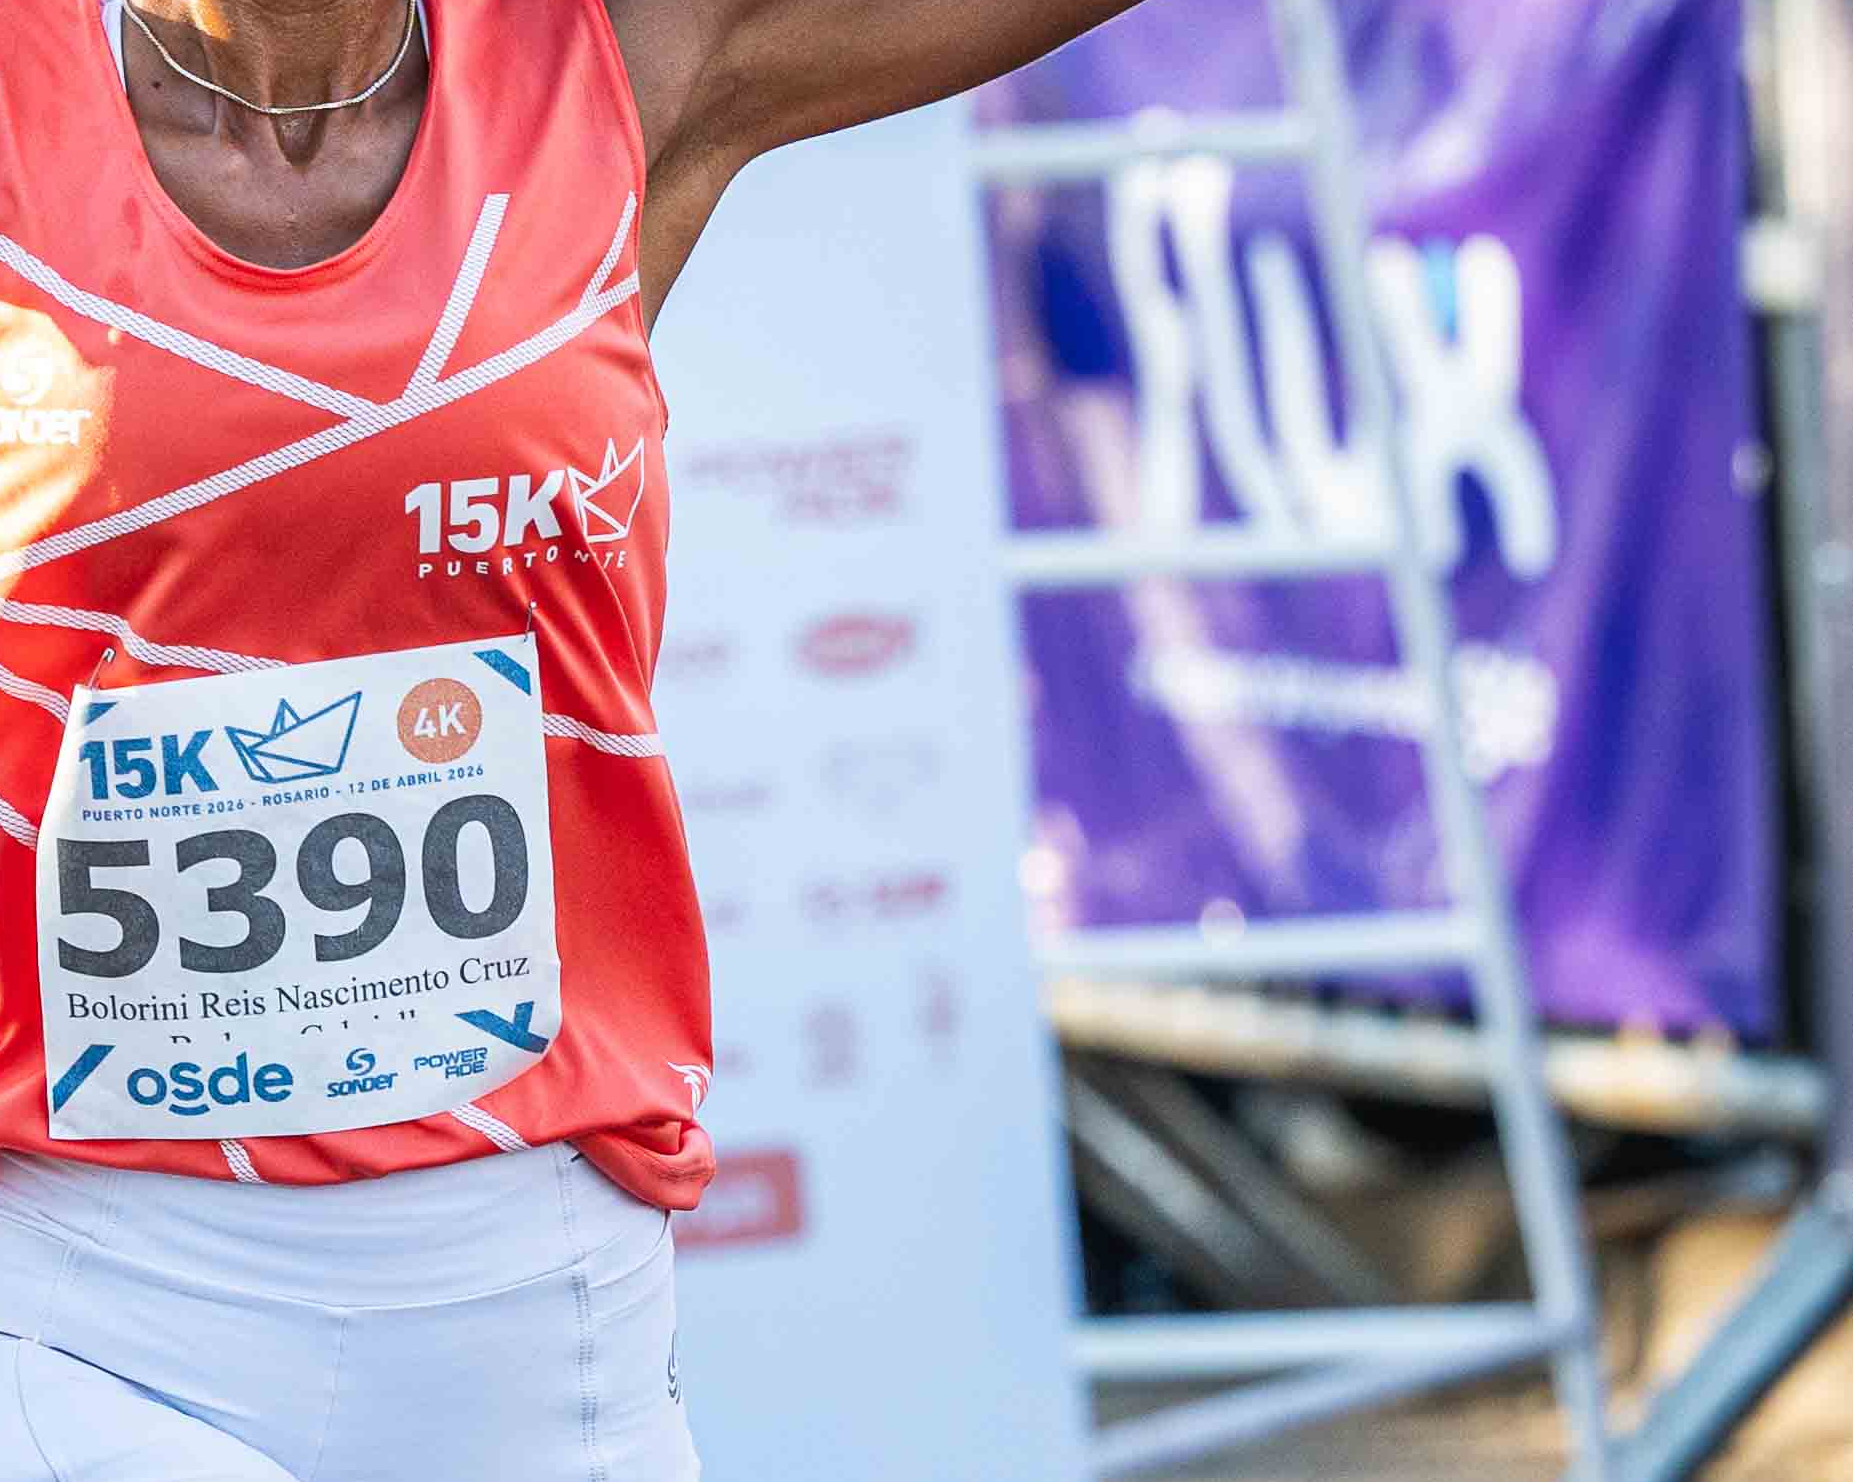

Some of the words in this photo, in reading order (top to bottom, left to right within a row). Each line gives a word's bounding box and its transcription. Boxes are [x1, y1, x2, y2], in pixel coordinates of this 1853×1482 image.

[404, 469, 566, 555] 15K
[419, 546, 558, 579] PUERTO
[574, 549, 628, 570] NTE
[413, 701, 466, 739] 4K
[79, 729, 220, 800] 15K
[82, 808, 144, 822] PUERTO
[149, 804, 201, 819] NORTE
[207, 799, 245, 815] 2026
[262, 787, 330, 807] ROSARIO
[348, 782, 365, 795] 12
[372, 779, 391, 791] DE
[396, 771, 442, 789] ABRIL
[448, 765, 485, 781] 2026
[56, 794, 529, 978] 5390
[67, 993, 189, 1021] Bolorini
[200, 989, 267, 1019] Reis
[275, 969, 450, 1013] Nascimento
[459, 956, 531, 985] Cruz
[126, 1050, 294, 1116] osde
[414, 1047, 488, 1071] POWER
